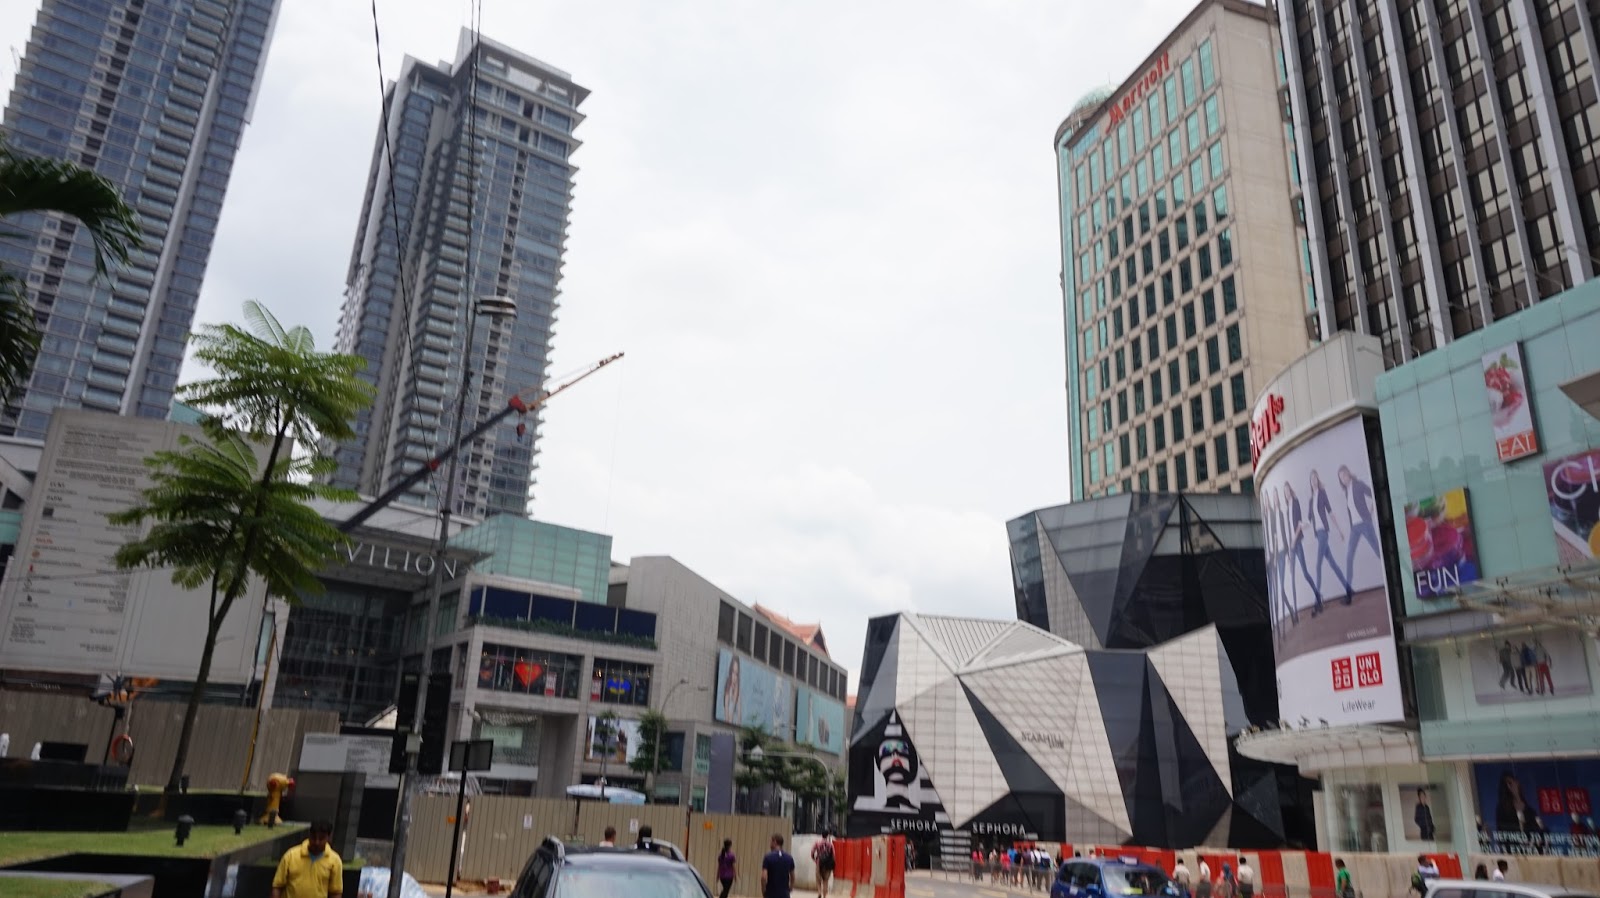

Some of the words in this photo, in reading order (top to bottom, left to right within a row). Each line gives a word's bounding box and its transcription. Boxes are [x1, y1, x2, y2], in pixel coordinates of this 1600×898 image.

[1105, 49, 1169, 135] Marriott
[1498, 432, 1532, 459] EAT
[333, 541, 458, 580] VILION
[1416, 564, 1461, 595] FUN
[1341, 699, 1376, 713] LifeWear
[890, 818, 938, 832] SEPHORA
[972, 822, 1026, 836] SEPHORA
